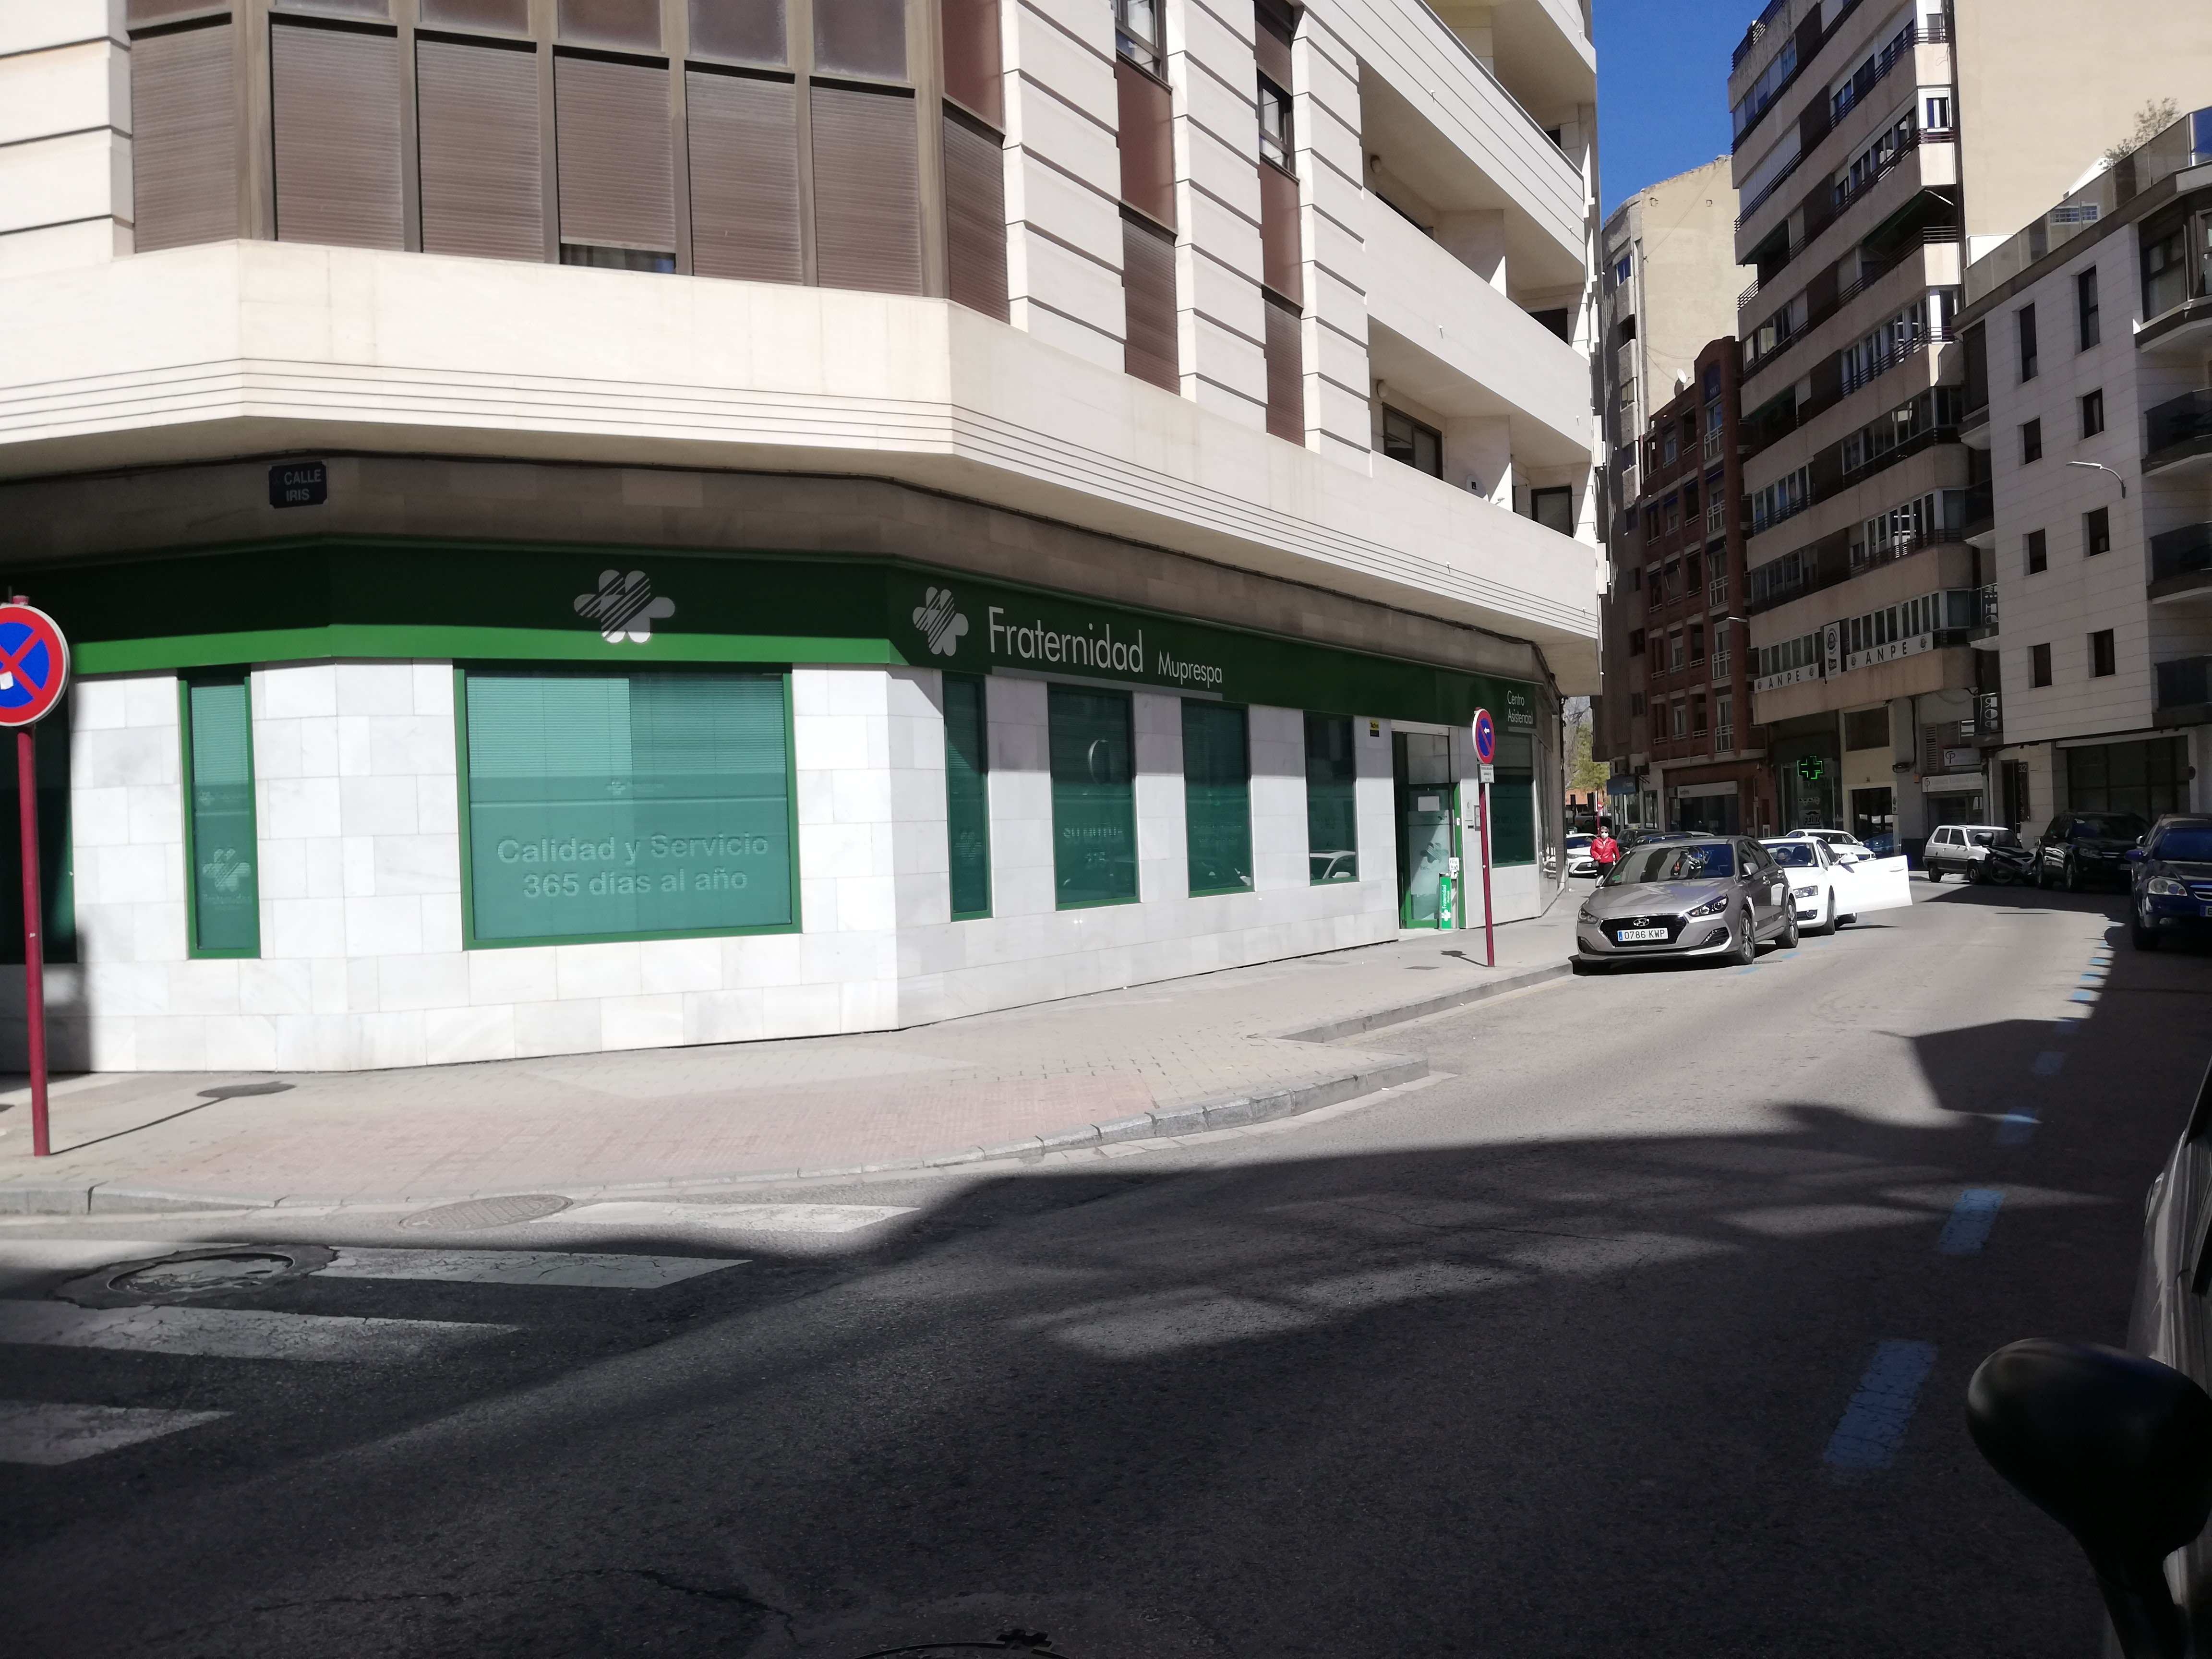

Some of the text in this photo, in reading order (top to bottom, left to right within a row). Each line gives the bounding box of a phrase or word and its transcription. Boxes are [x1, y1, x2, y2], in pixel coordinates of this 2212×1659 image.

[284, 469, 321, 485] CALLE
[286, 488, 310, 502] IRIS
[988, 606, 1223, 688] Fraternidad Muprespa
[1866, 642, 1907, 664] ANPE
[1769, 670, 1800, 689] ANPE
[1507, 690, 1525, 706] Centro
[1508, 708, 1533, 724] Asistencial
[2018, 764, 2027, 773] 32
[497, 832, 769, 865] Calidad y Servicio
[523, 866, 747, 898] 365 días al año
[1624, 929, 1665, 939] 0786 KWP
